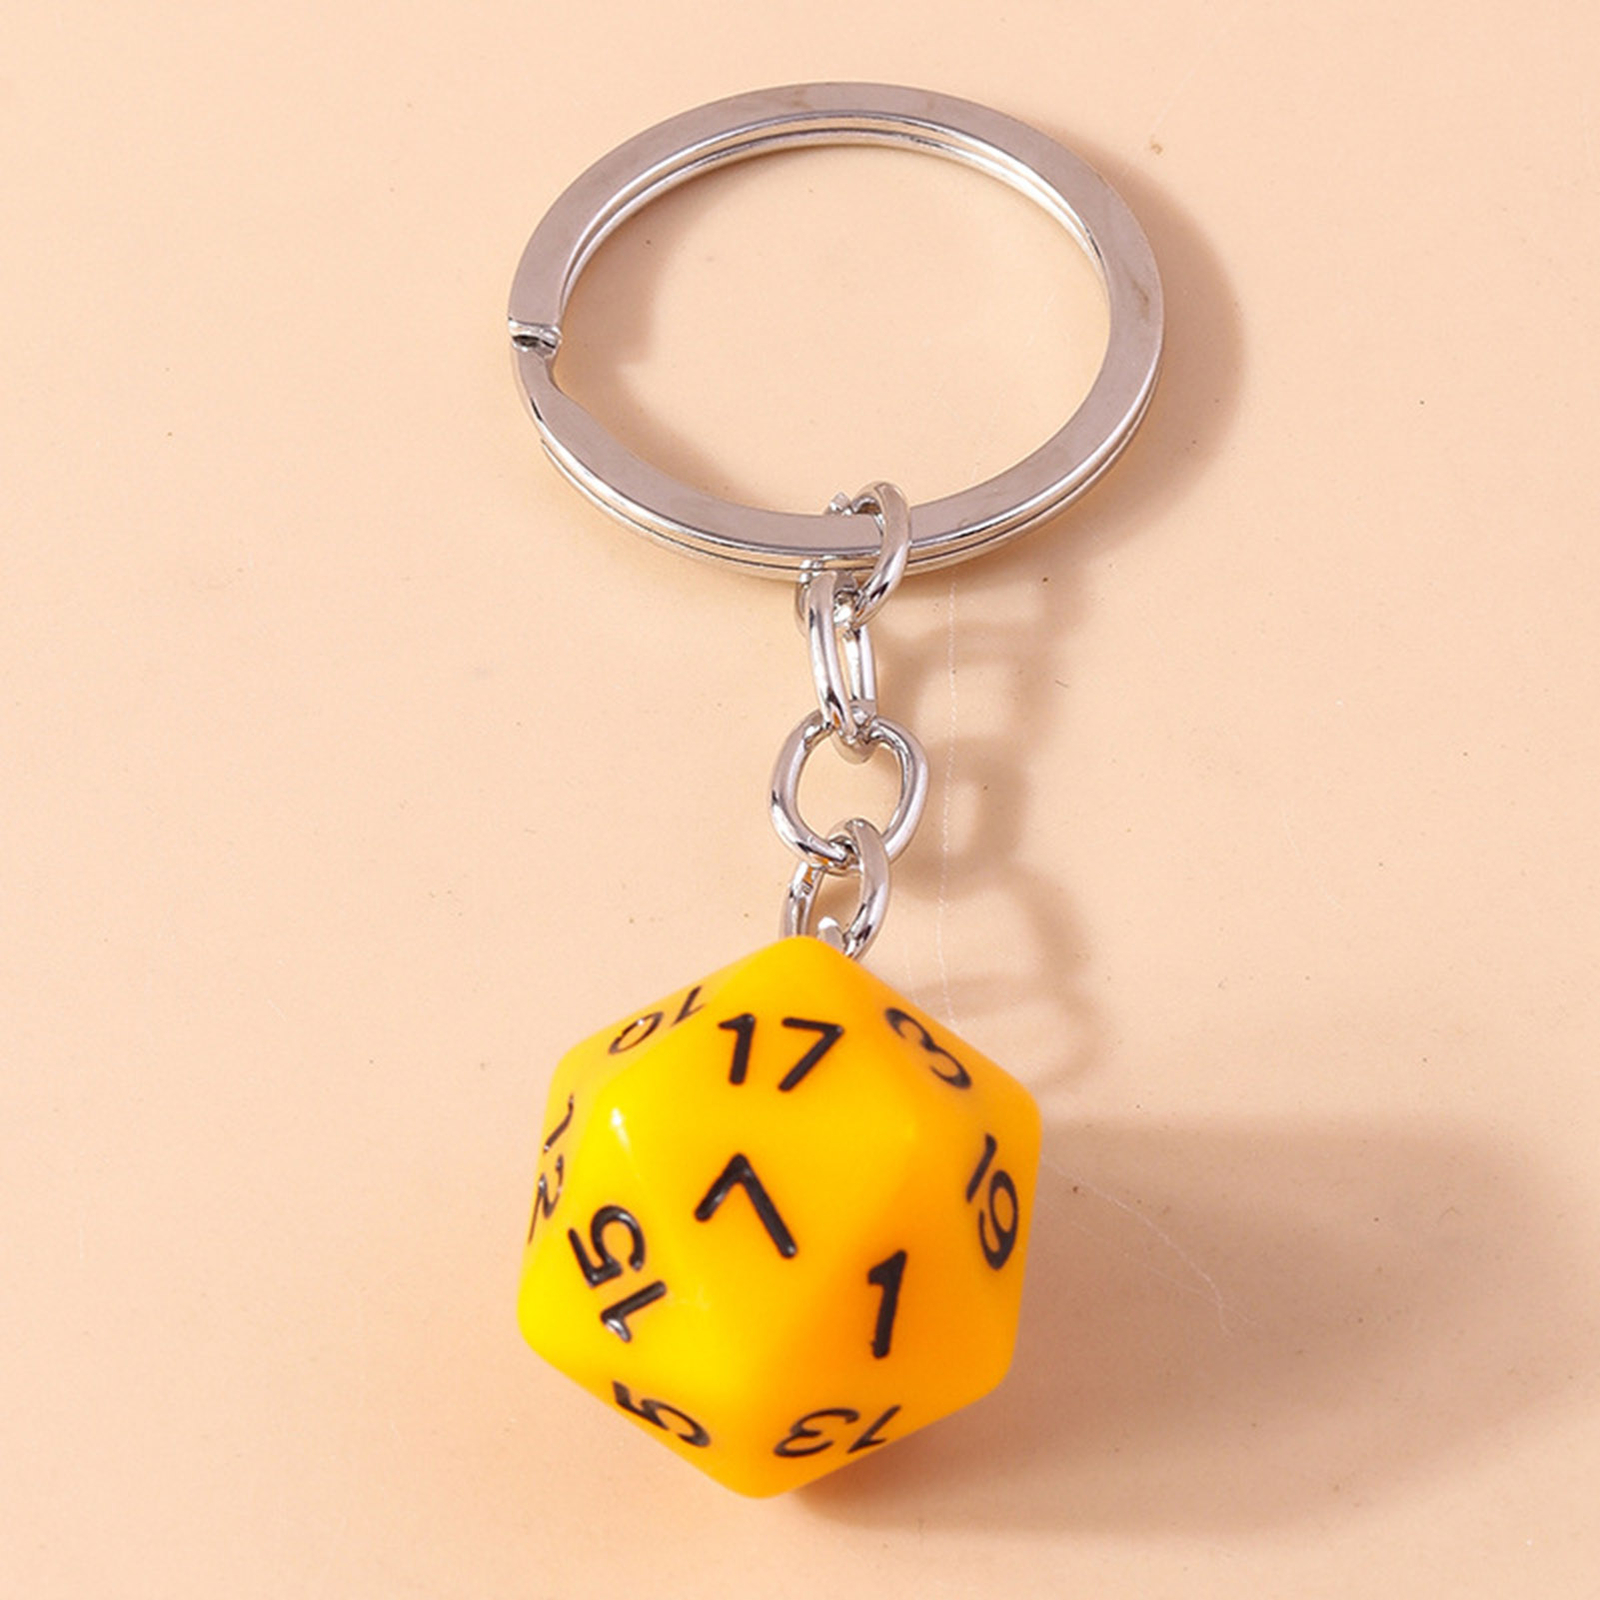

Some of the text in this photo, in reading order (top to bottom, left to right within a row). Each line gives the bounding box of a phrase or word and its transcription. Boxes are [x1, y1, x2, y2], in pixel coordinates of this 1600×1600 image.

[607, 984, 706, 1056] 10
[718, 1012, 844, 1093] 17
[886, 1007, 971, 1090] 3
[694, 1153, 798, 1259] 7
[965, 1133, 1020, 1271] 19
[568, 1204, 668, 1343] 15
[867, 1249, 908, 1359] 1
[612, 1380, 711, 1449] 5
[773, 1404, 903, 1458] 13
